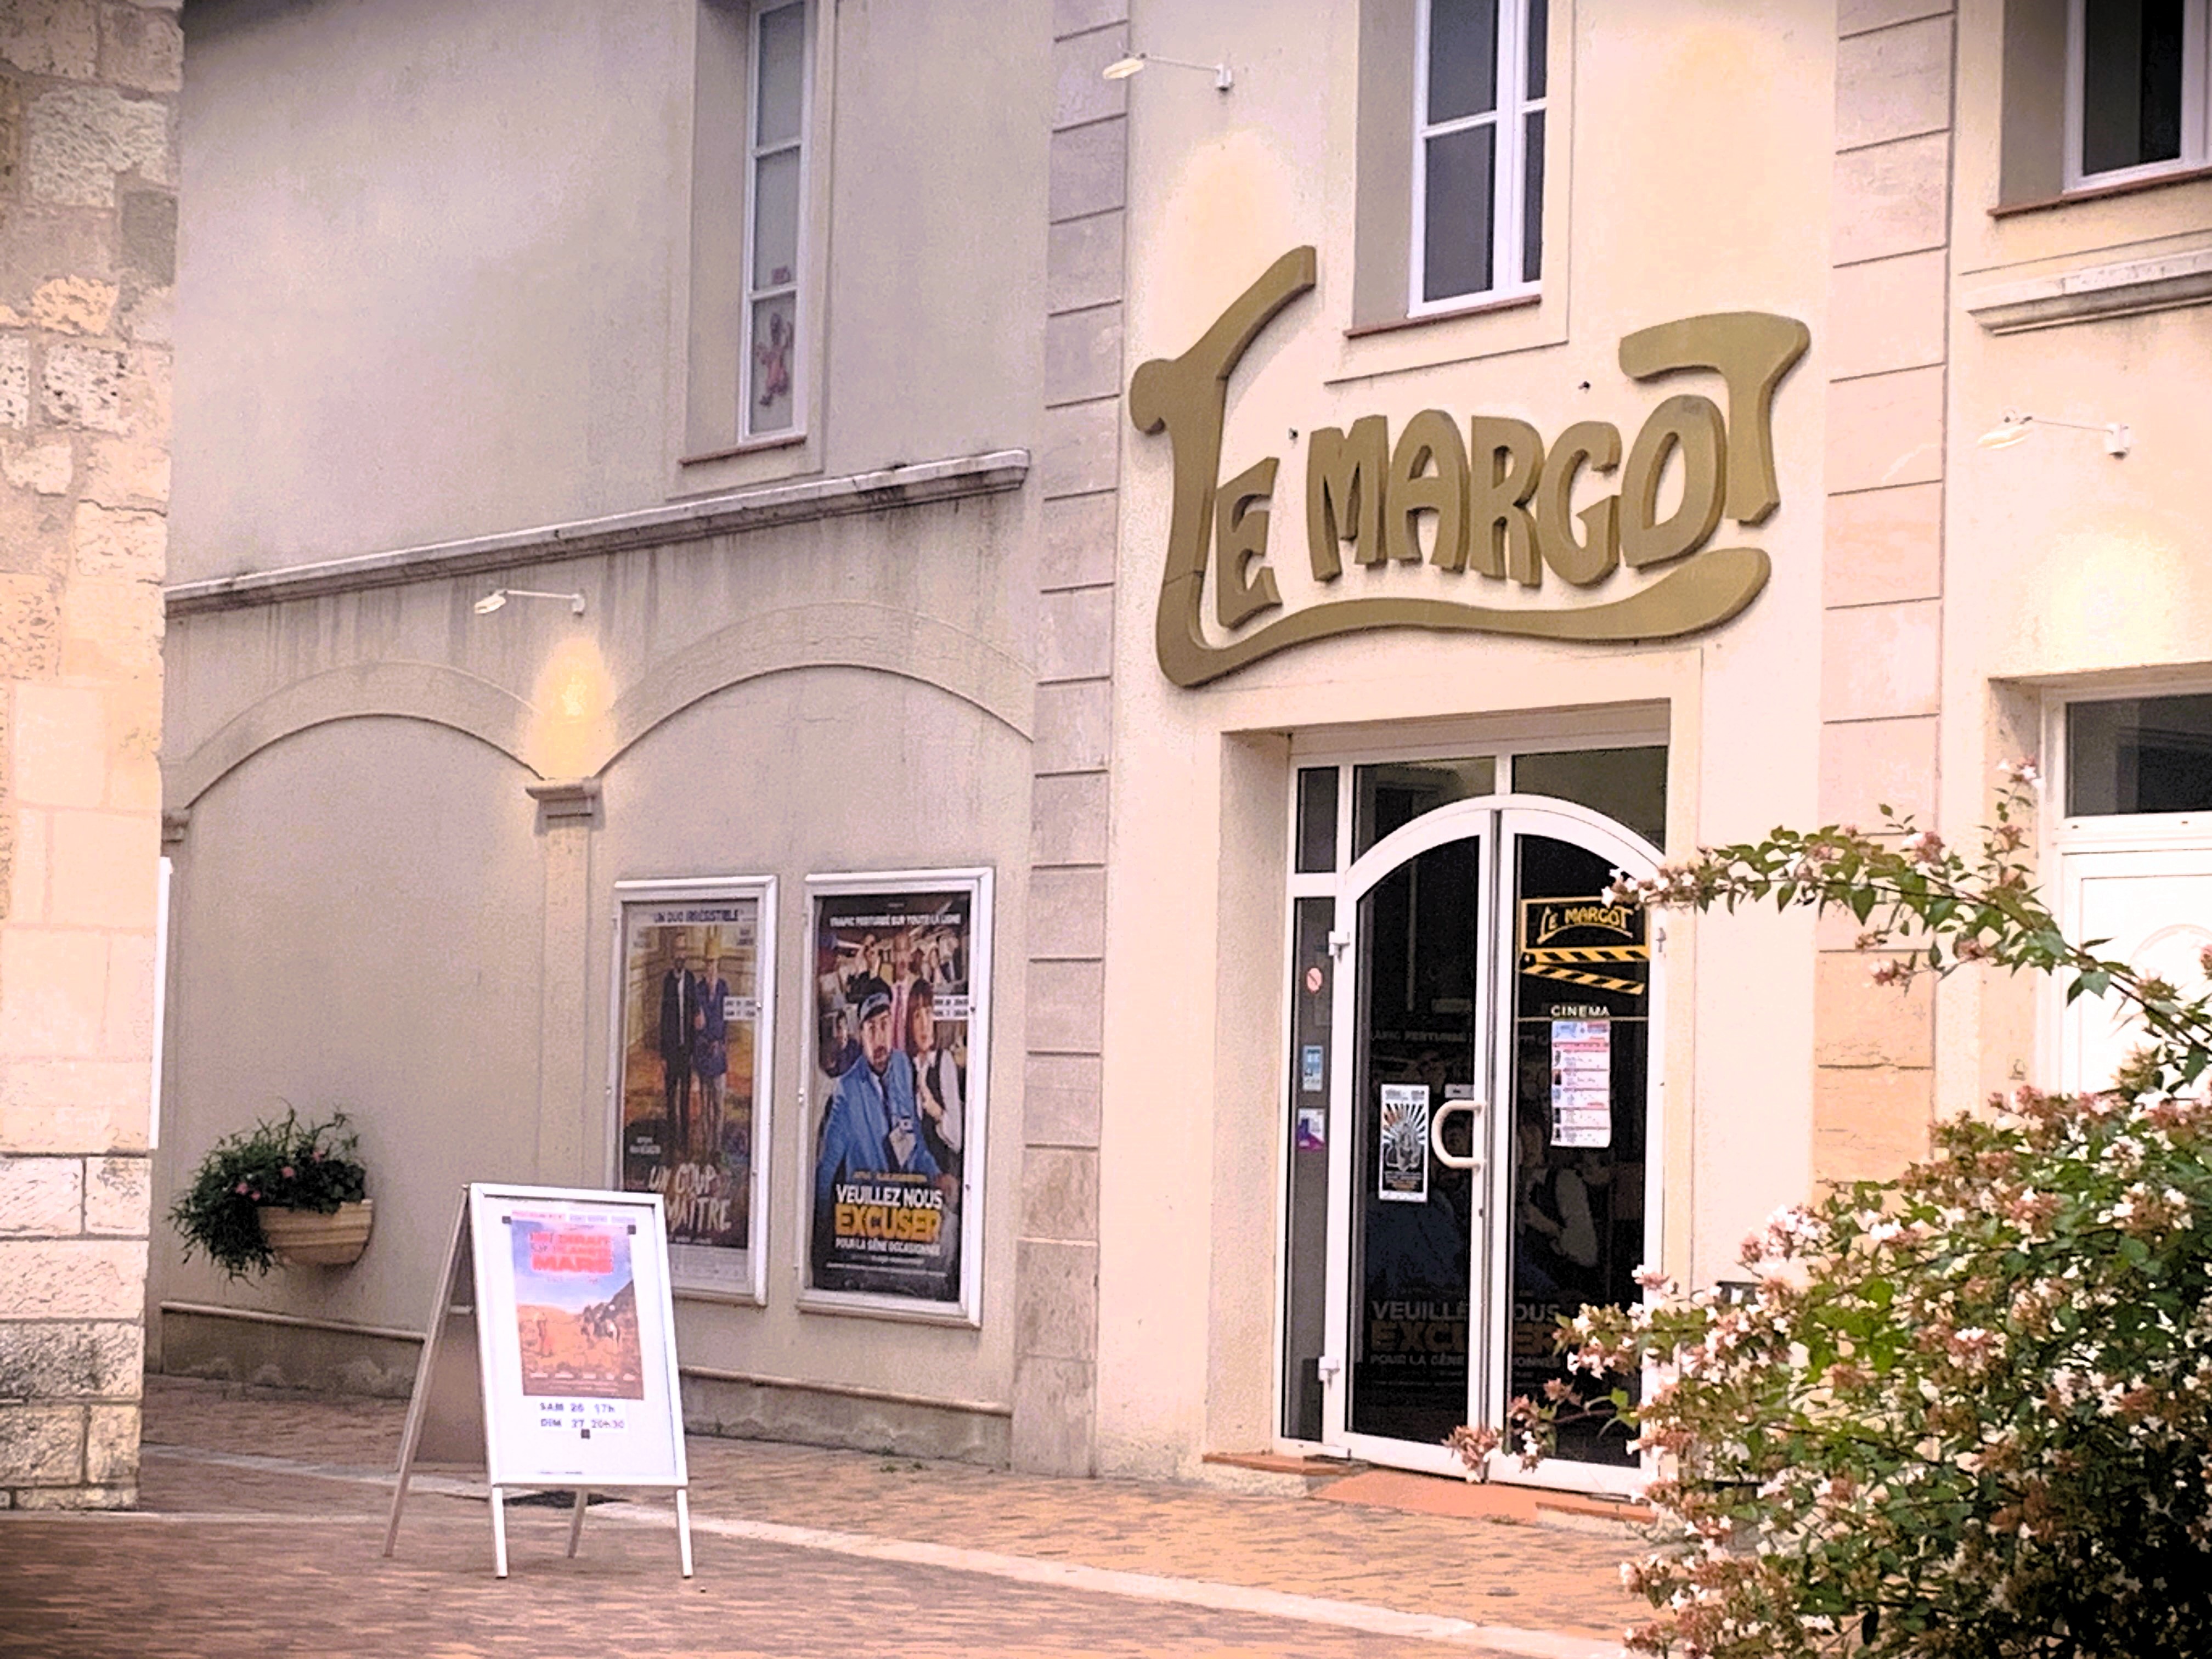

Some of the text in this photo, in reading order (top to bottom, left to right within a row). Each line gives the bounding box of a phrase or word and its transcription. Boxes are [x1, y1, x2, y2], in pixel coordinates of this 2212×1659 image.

[1306, 311, 1811, 589] MARGOT
[1565, 906, 1634, 930] MARGOT
[836, 1184, 944, 1210] VEUILLEZ NOUS
[835, 1203, 941, 1244] EXCUSER
[1372, 1300, 1468, 1321] VEUILLE
